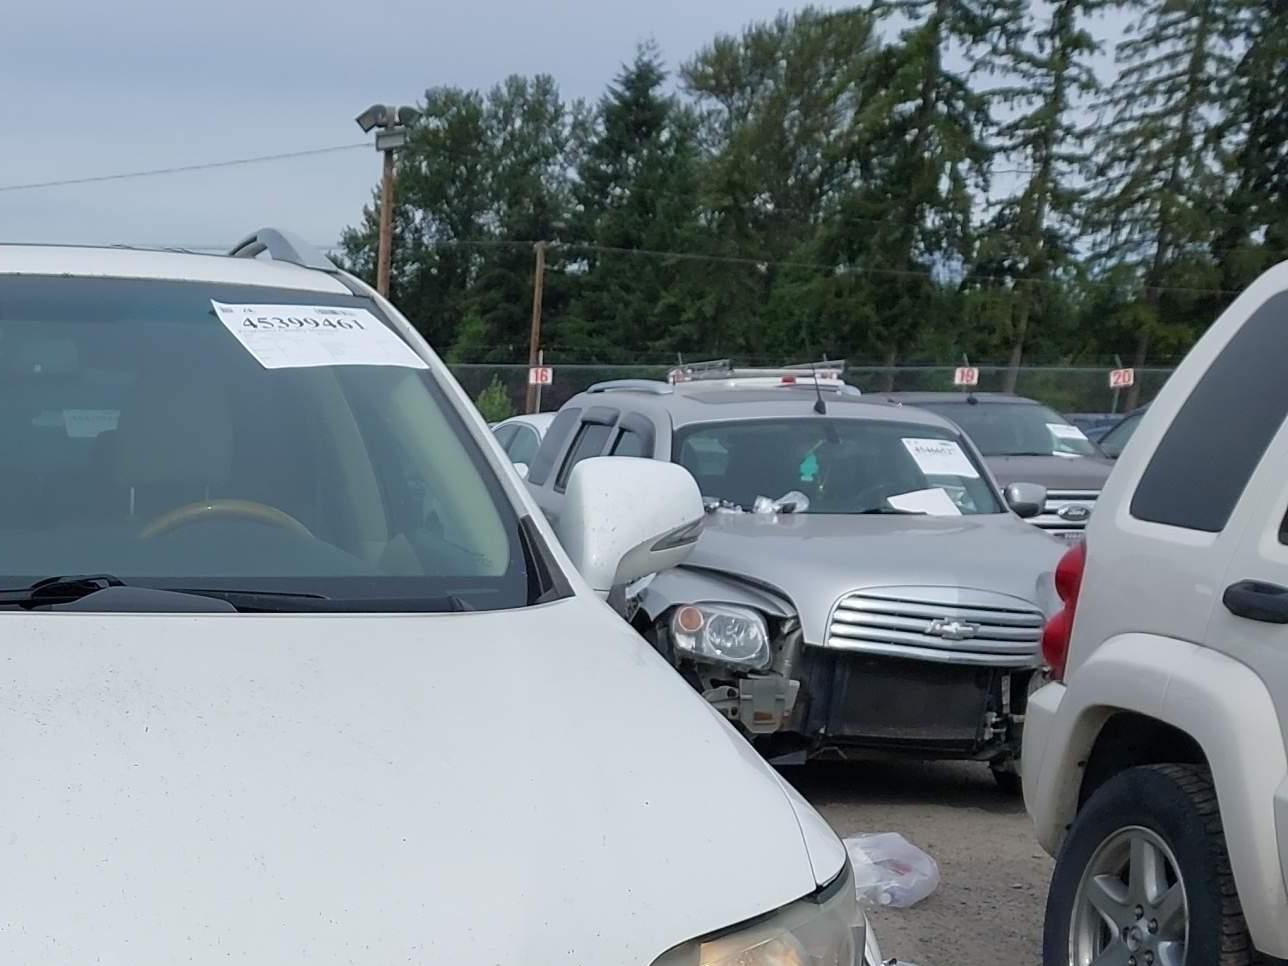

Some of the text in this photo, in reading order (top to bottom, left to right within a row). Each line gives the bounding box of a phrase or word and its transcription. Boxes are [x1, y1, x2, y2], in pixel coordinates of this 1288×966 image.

[242, 316, 366, 331] 45399461
[535, 368, 548, 384] 16
[1113, 370, 1131, 385] 20
